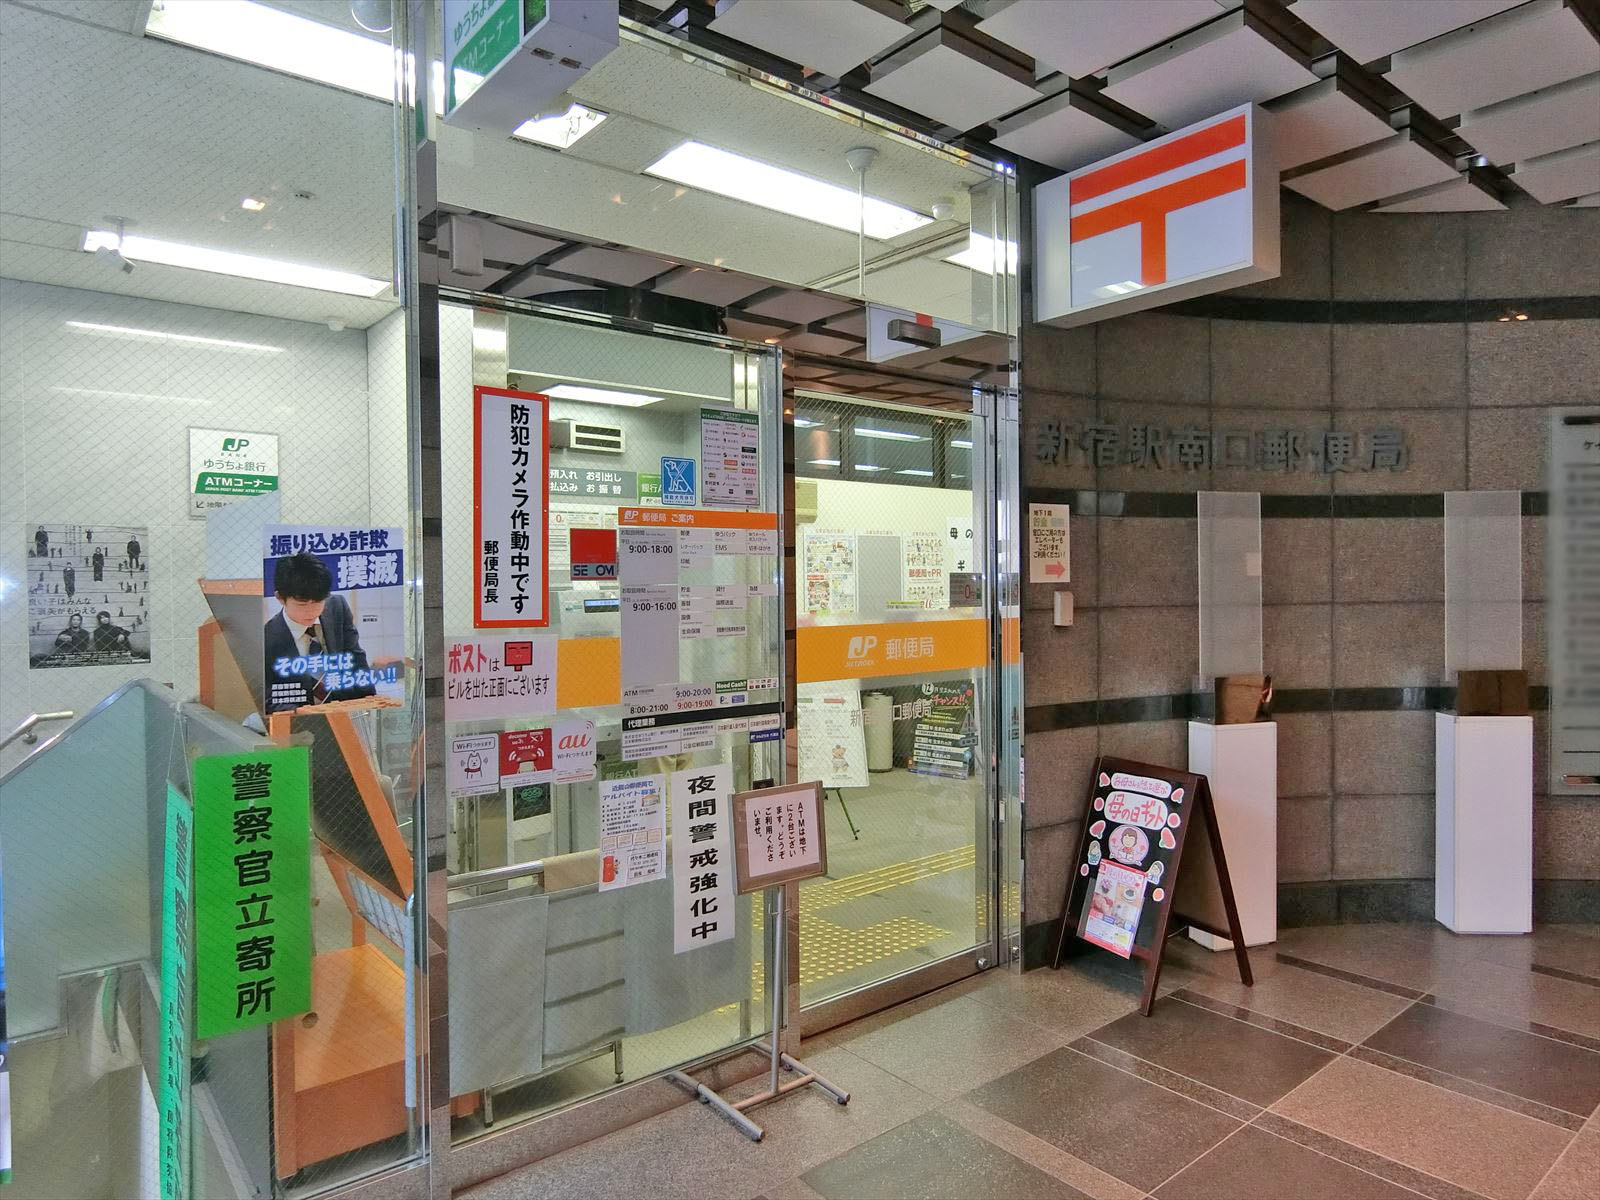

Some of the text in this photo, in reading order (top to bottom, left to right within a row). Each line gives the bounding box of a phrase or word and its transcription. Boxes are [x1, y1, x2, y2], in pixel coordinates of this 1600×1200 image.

[1036, 420, 1409, 474] 新宿駅南口郵便局
[203, 458, 267, 473] ゆうちょ銀行
[586, 471, 622, 482] お引出し
[204, 476, 273, 488] ATMコーナー
[509, 403, 531, 615] 防犯カメラ作動中です
[641, 512, 667, 523] 郵便局
[671, 513, 695, 524] ご案内
[270, 529, 389, 557] 振り込め詐欺
[628, 544, 673, 554] 9:00-18:00
[714, 544, 728, 552] EMS
[337, 551, 398, 590] 撲滅
[483, 540, 500, 605] 郵便局長
[573, 564, 615, 577] SEOM
[632, 602, 677, 612] 9:00-16:00
[448, 643, 500, 674] ポストは
[885, 636, 935, 661] 郵便局
[274, 652, 354, 678] その手には
[624, 689, 639, 697] ATM
[676, 688, 712, 698] 9:00-20:00
[716, 680, 747, 691] Need Cash?
[629, 703, 669, 714] 8:00-21:00
[677, 699, 713, 710] 9:00-19:00
[558, 733, 592, 750] au
[1107, 793, 1164, 828] 母の日ギフト
[753, 809, 763, 838] いませ。
[765, 806, 775, 862] ご利用くださ
[776, 806, 785, 860] ます。どうぞ
[787, 803, 797, 858] に2台ござい
[797, 801, 807, 856] ATMは地下
[687, 773, 719, 940] 夜間警戒強化中
[231, 763, 277, 1020] 警察官立寄所
